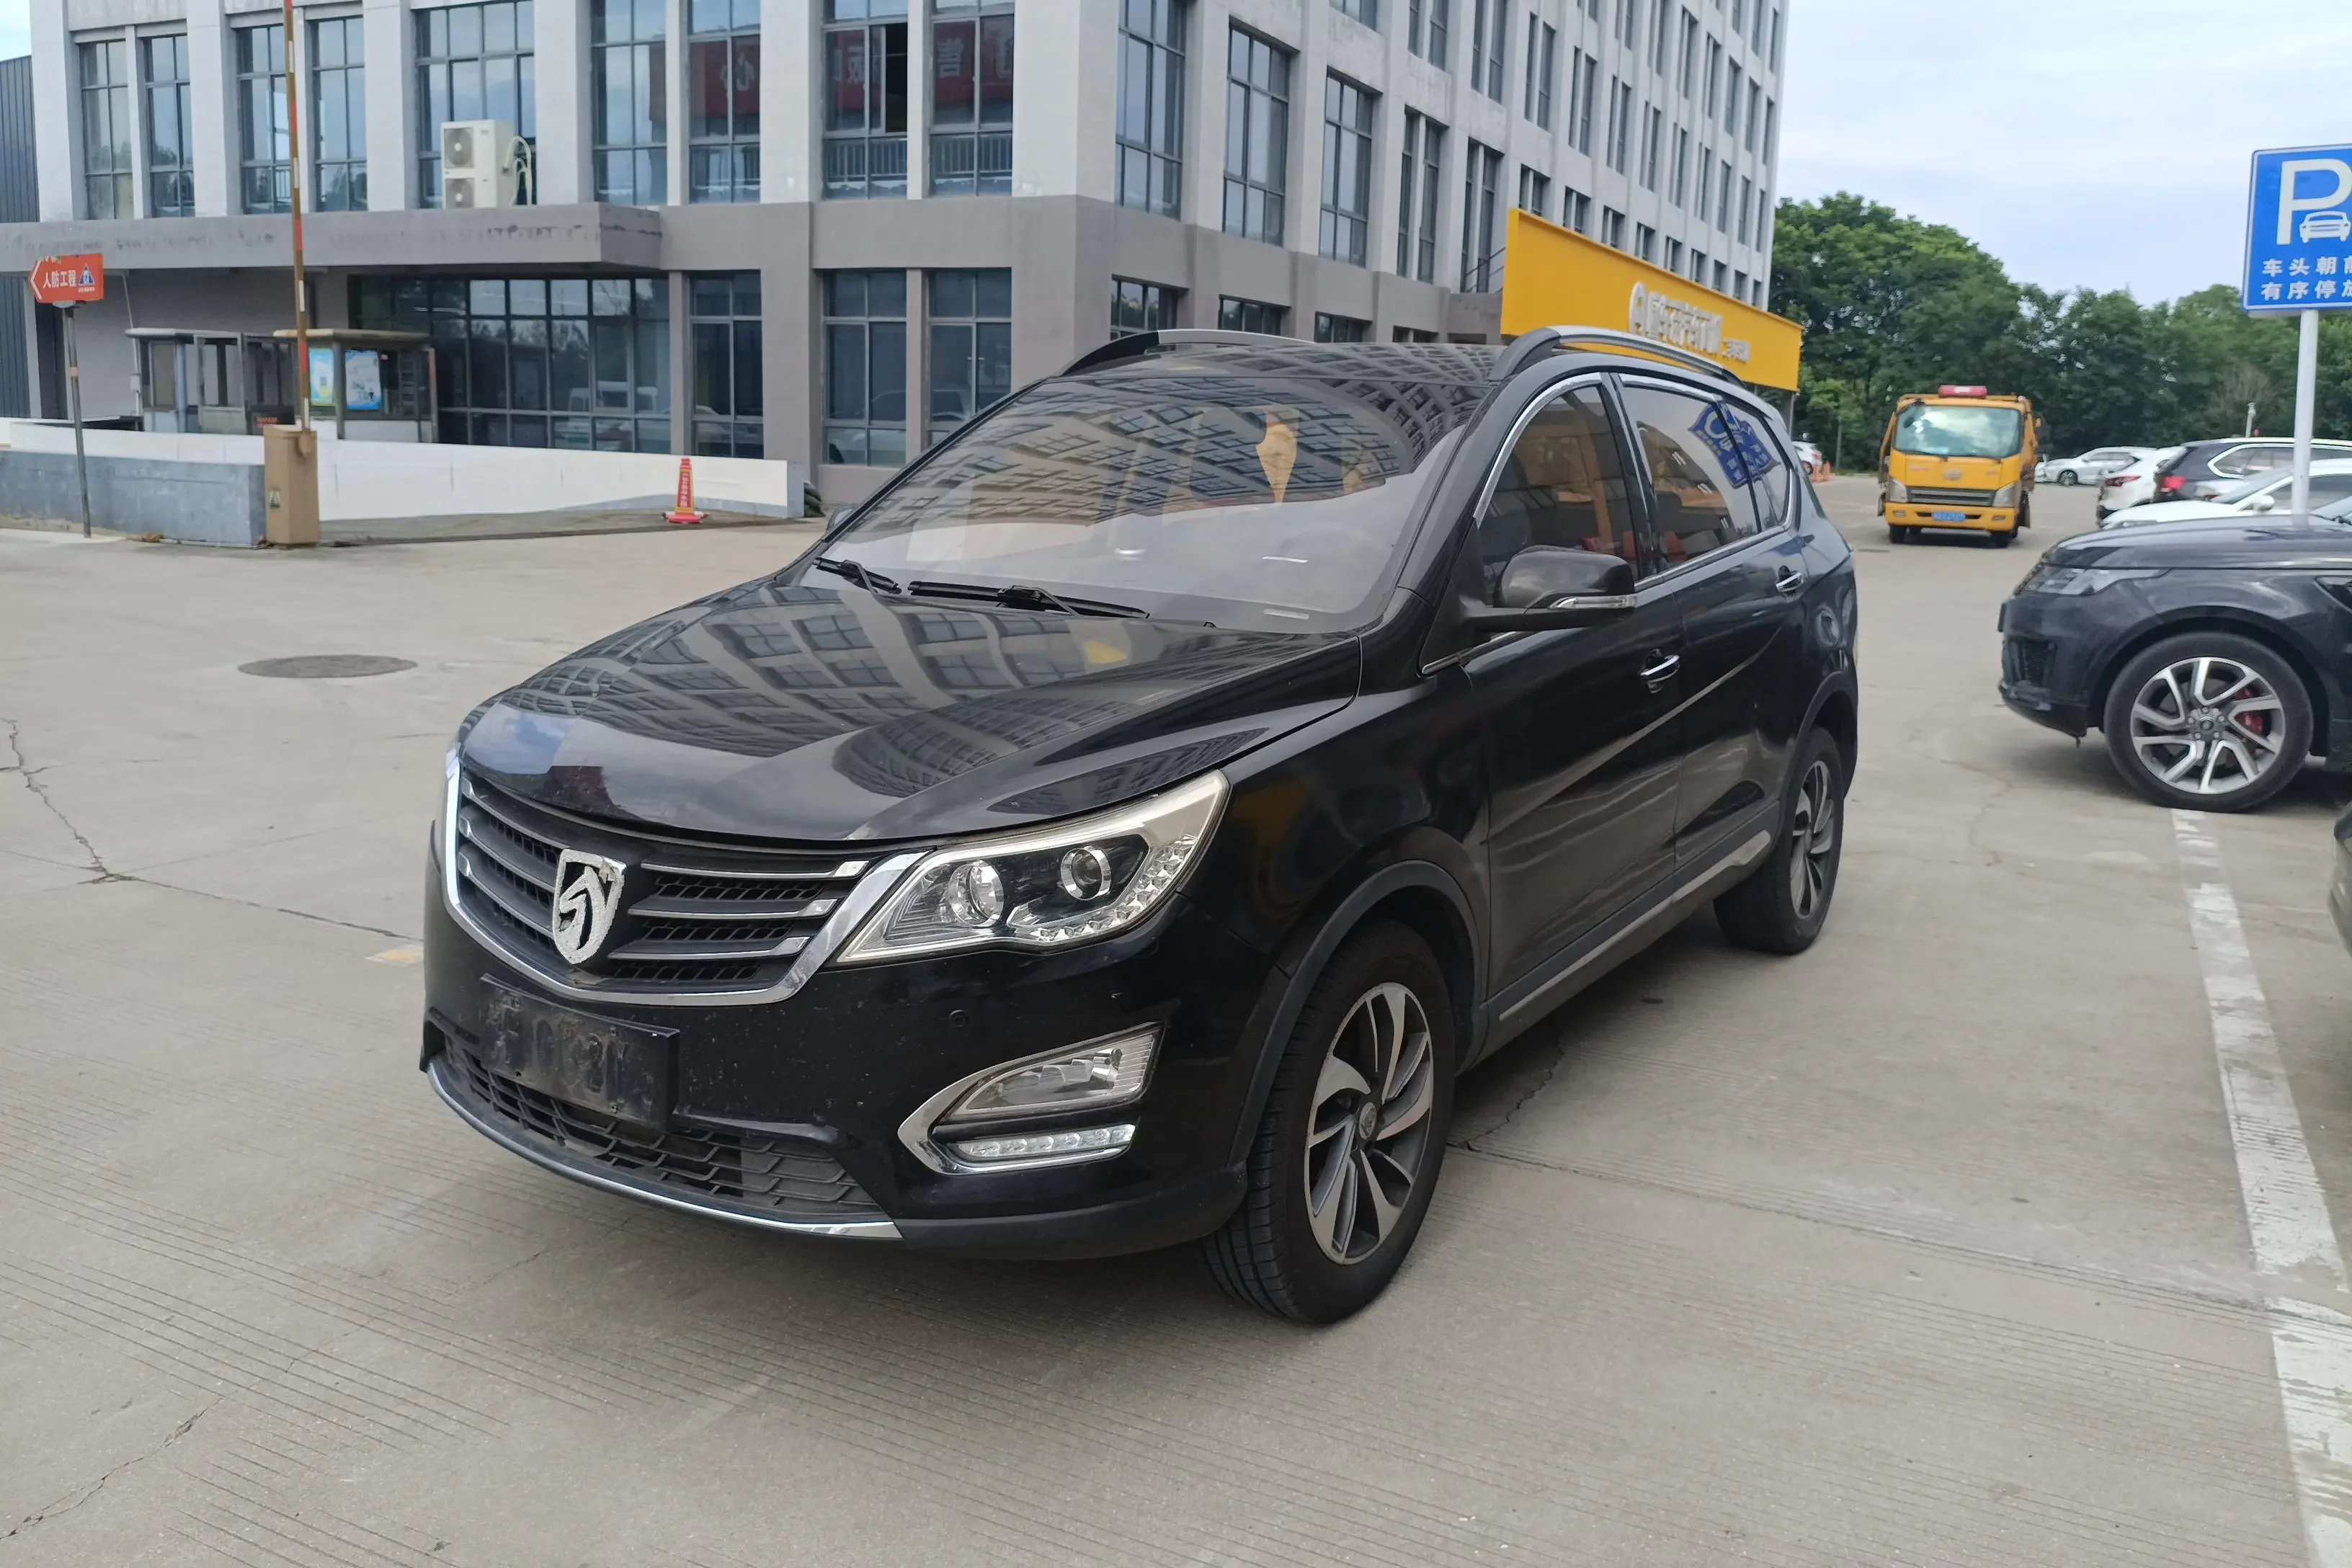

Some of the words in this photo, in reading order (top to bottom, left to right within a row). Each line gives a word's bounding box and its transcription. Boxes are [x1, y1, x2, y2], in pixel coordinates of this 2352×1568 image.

[2276, 158, 2352, 245] P
[43, 270, 76, 288] 人防工程
